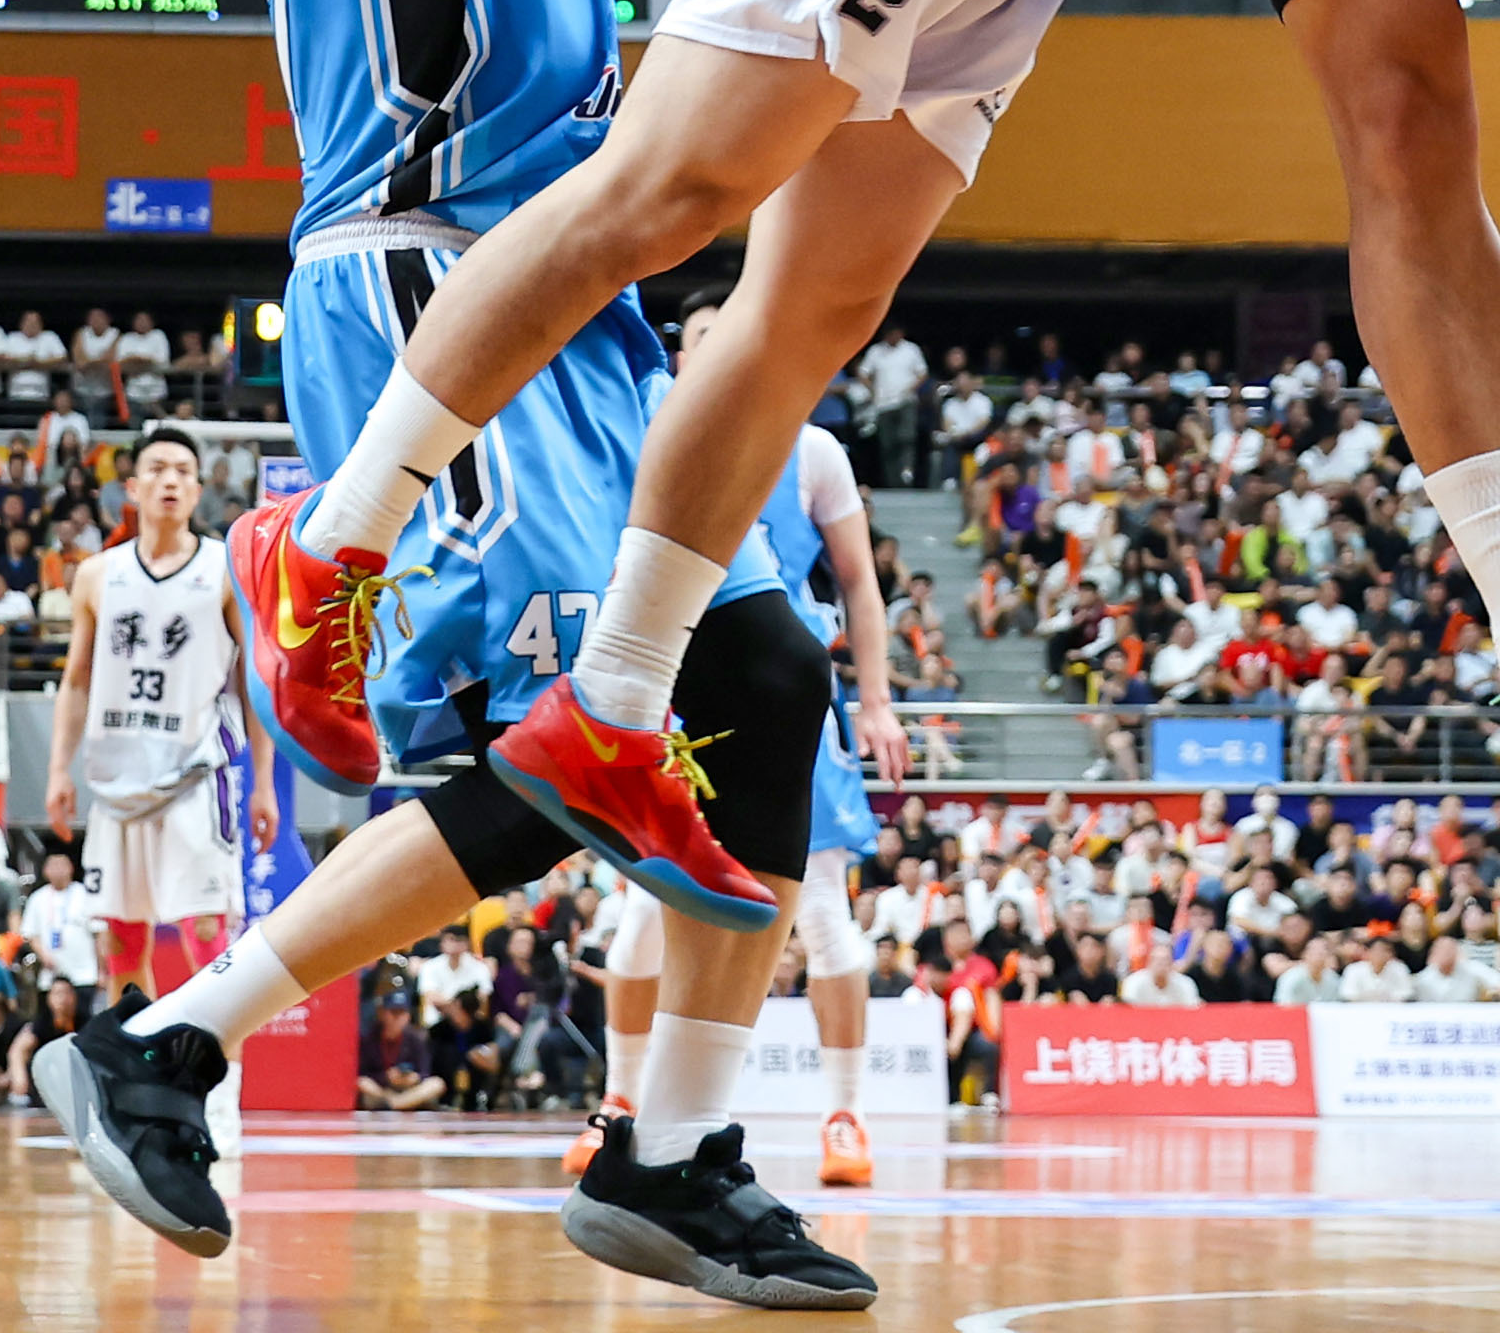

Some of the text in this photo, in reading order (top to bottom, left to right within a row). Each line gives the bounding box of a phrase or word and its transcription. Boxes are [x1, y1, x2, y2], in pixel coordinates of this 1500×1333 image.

[504, 589, 600, 676] 47
[130, 669, 165, 702] 33
[1022, 1036, 1298, 1087] 上饶市体育局
